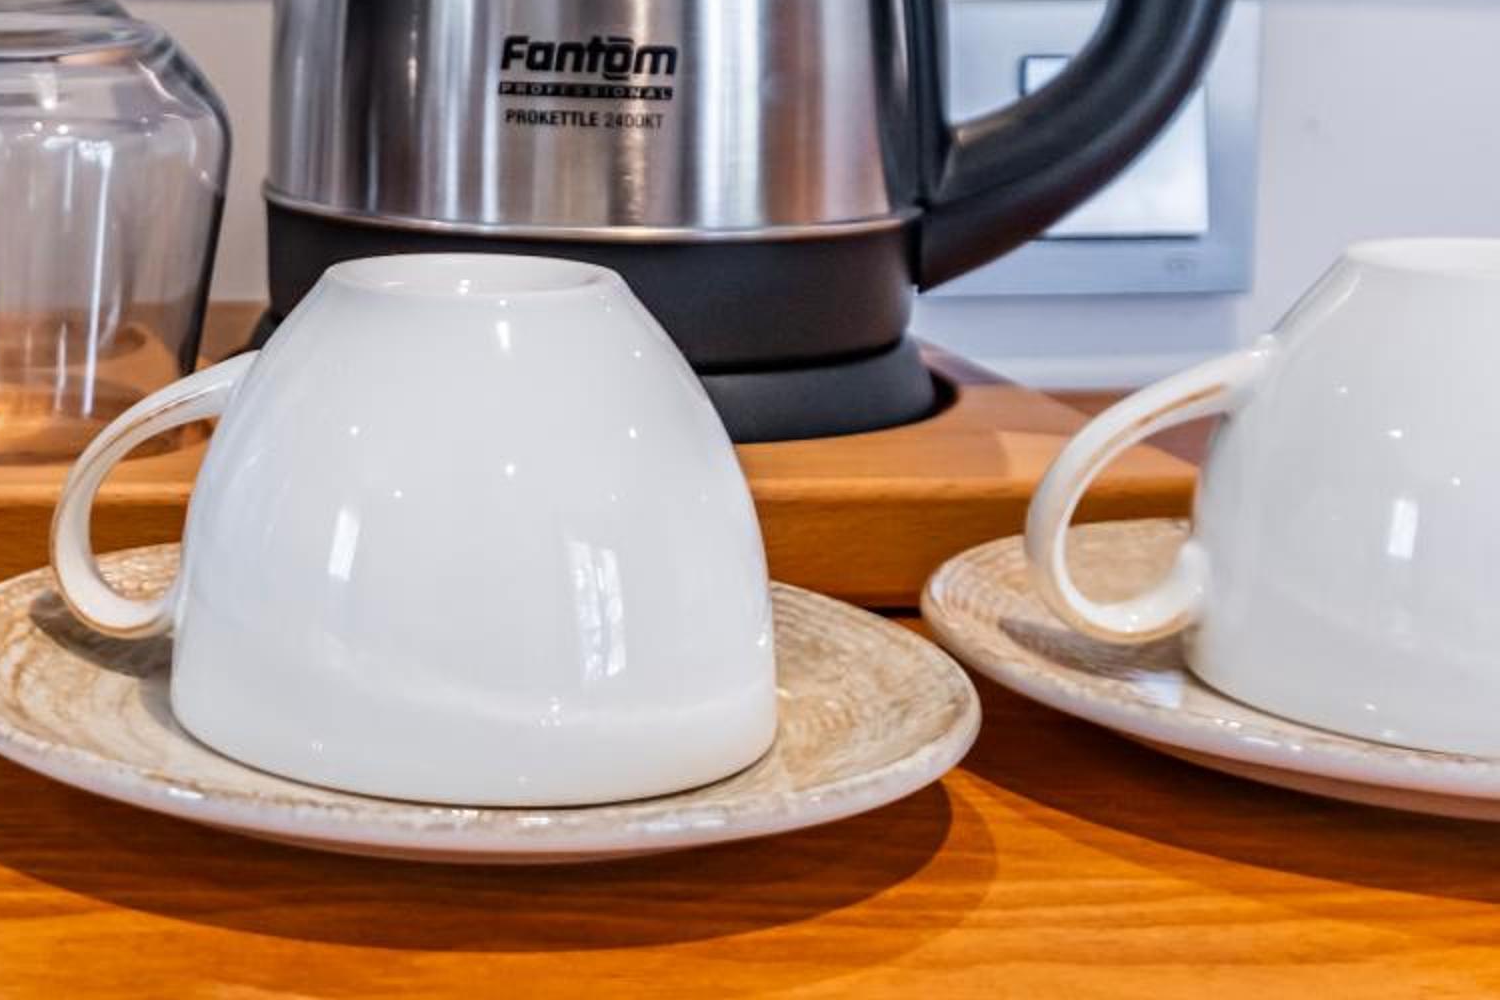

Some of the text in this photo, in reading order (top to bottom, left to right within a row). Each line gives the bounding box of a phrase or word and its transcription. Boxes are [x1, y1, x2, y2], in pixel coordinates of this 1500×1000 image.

[500, 82, 672, 100] PROFESSIONAL
[505, 109, 664, 129] PROKETTLE 2400KT
